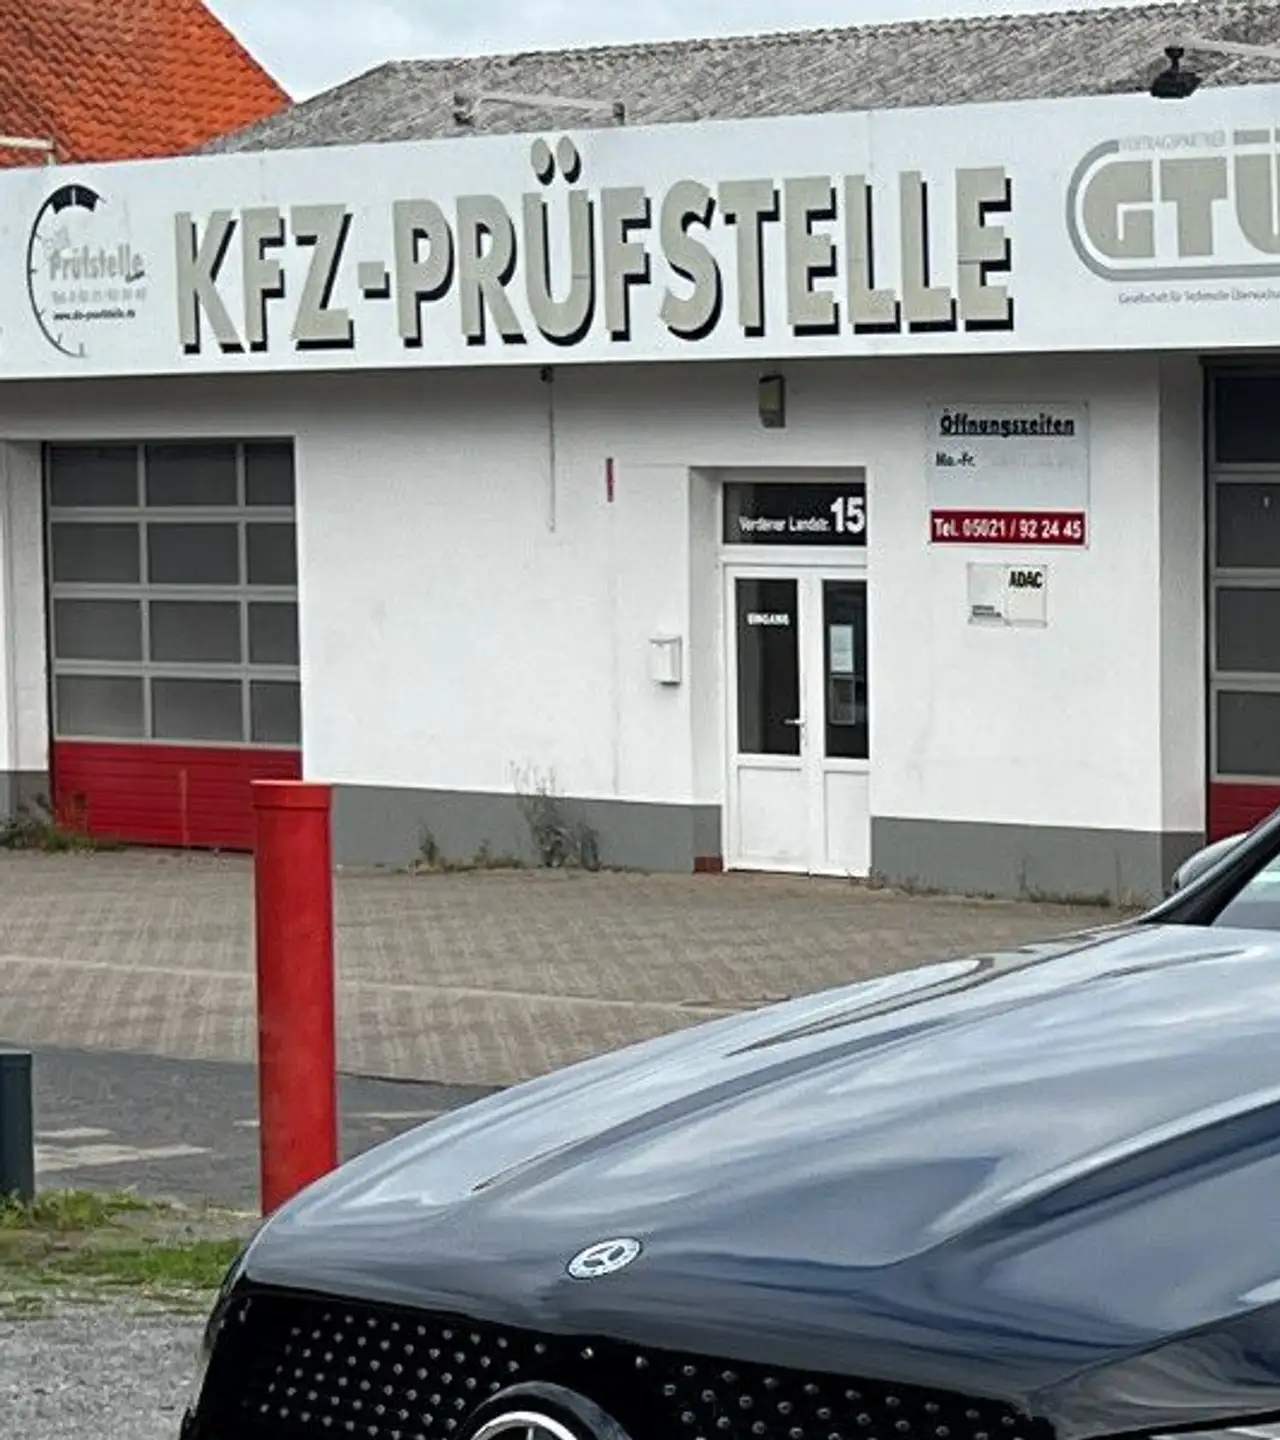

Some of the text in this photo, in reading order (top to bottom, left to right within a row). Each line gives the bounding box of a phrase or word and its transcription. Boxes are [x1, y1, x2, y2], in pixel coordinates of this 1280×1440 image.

[175, 136, 1014, 355] KFZ-PRÜFSTELLE
[939, 408, 1076, 437] Öffnungszeiten
[829, 496, 866, 534] 15
[934, 518, 959, 538] Tel.
[962, 519, 1006, 538] 05021
[1018, 519, 1039, 539] 92
[1041, 520, 1061, 539] 24
[1062, 520, 1082, 539] 45
[1008, 571, 1044, 589] ADAC
